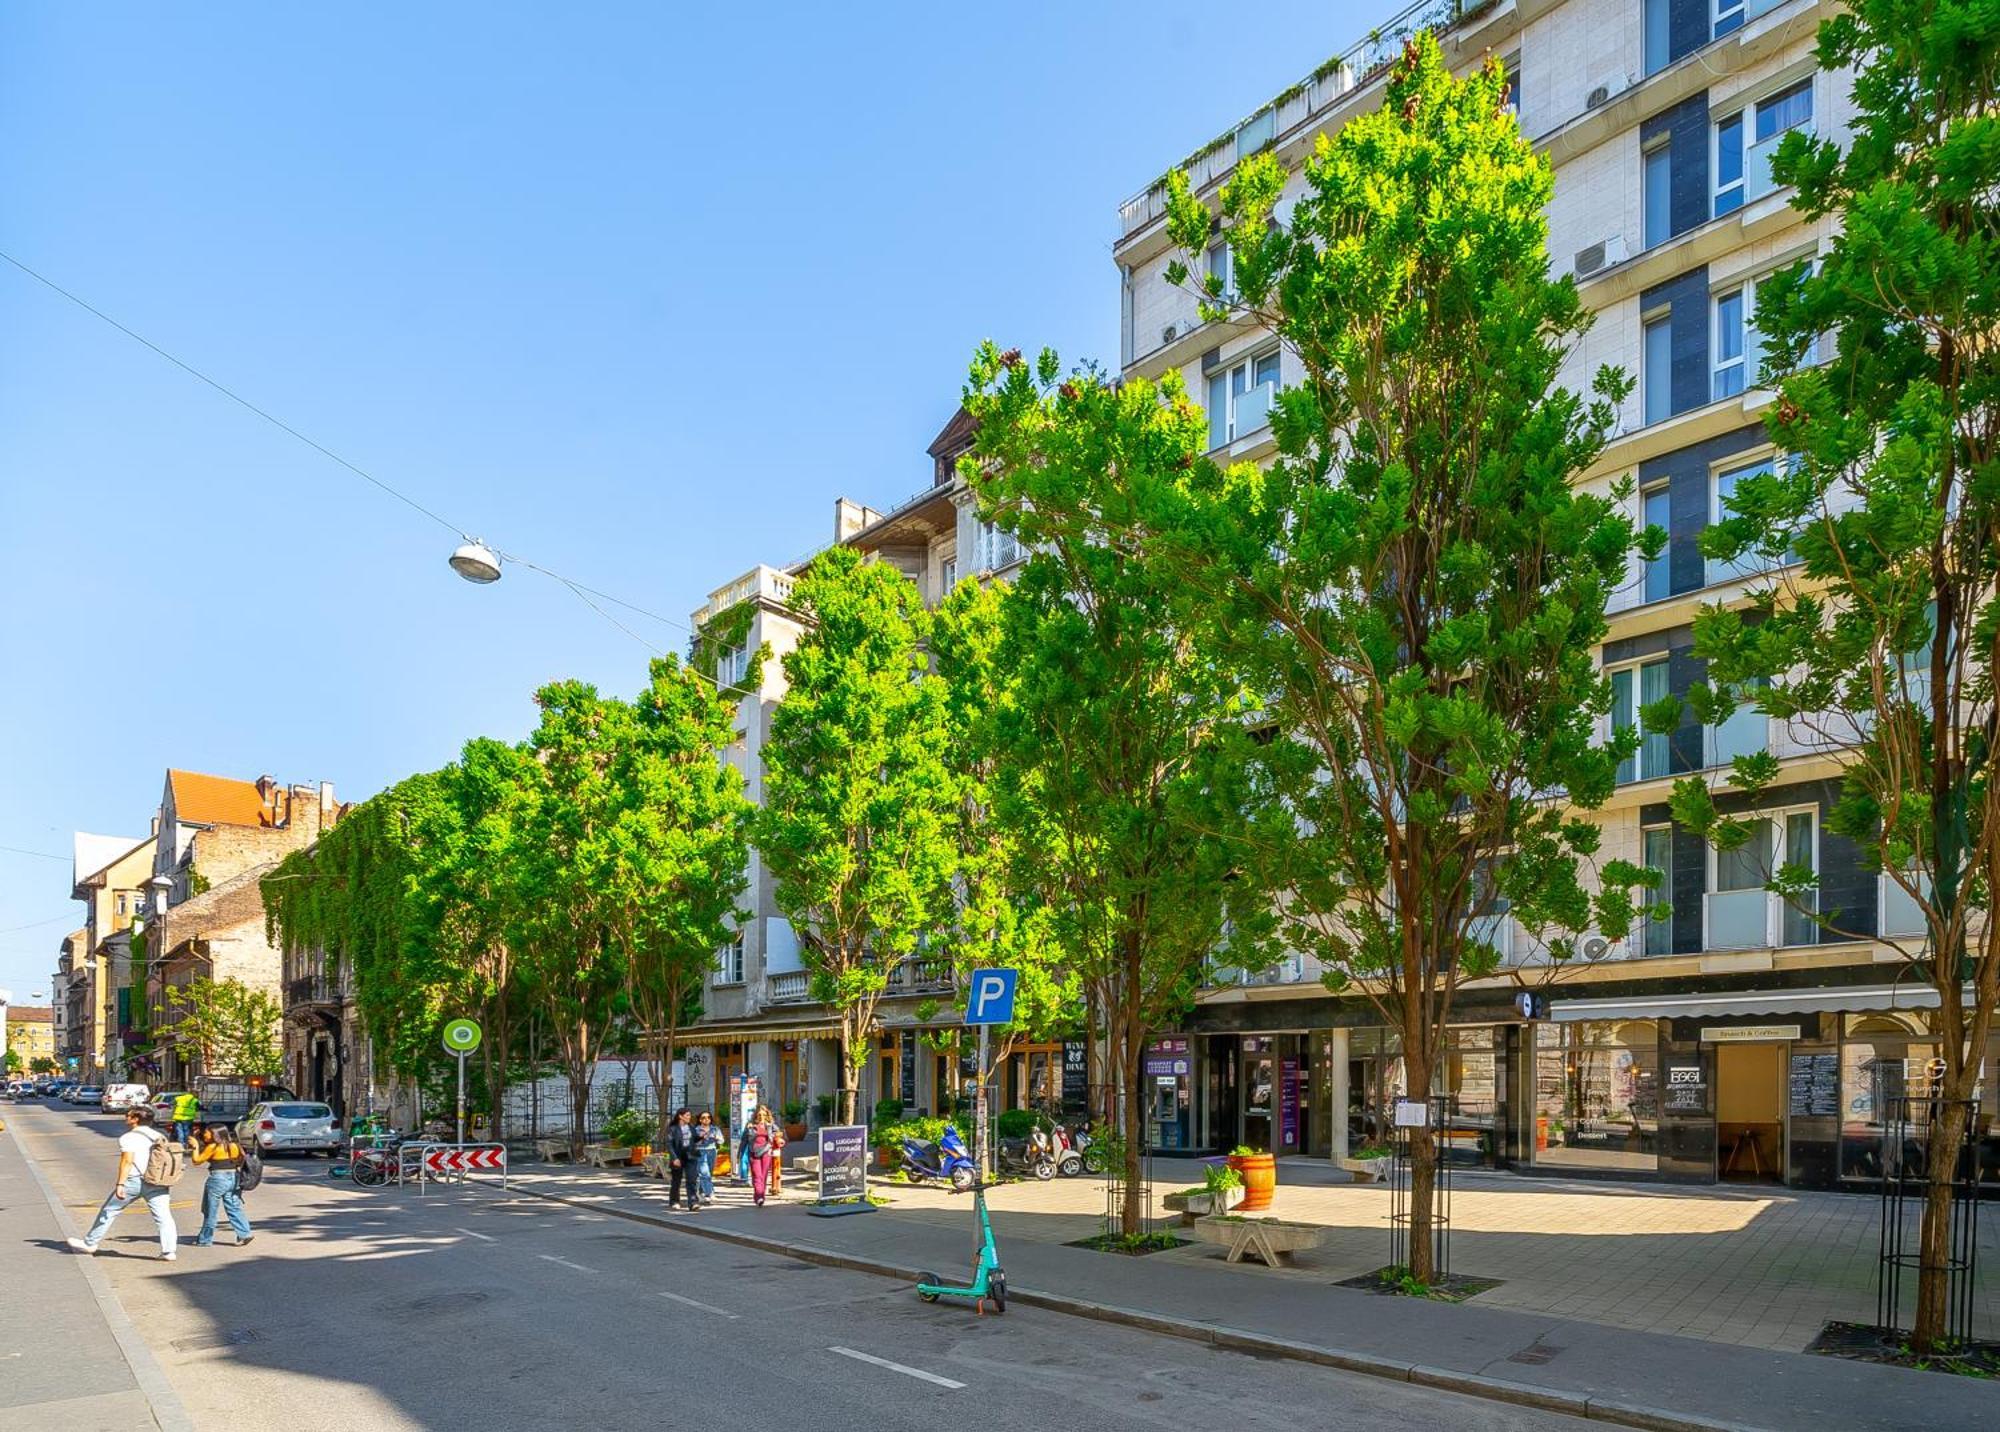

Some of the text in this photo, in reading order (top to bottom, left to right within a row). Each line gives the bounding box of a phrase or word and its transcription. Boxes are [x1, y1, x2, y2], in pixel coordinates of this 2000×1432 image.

[977, 976, 1005, 1017] P
[1671, 1071, 1700, 1083] EGGI
[835, 1137, 862, 1145] LUGGAGE
[835, 1144, 862, 1152] STORAGE
